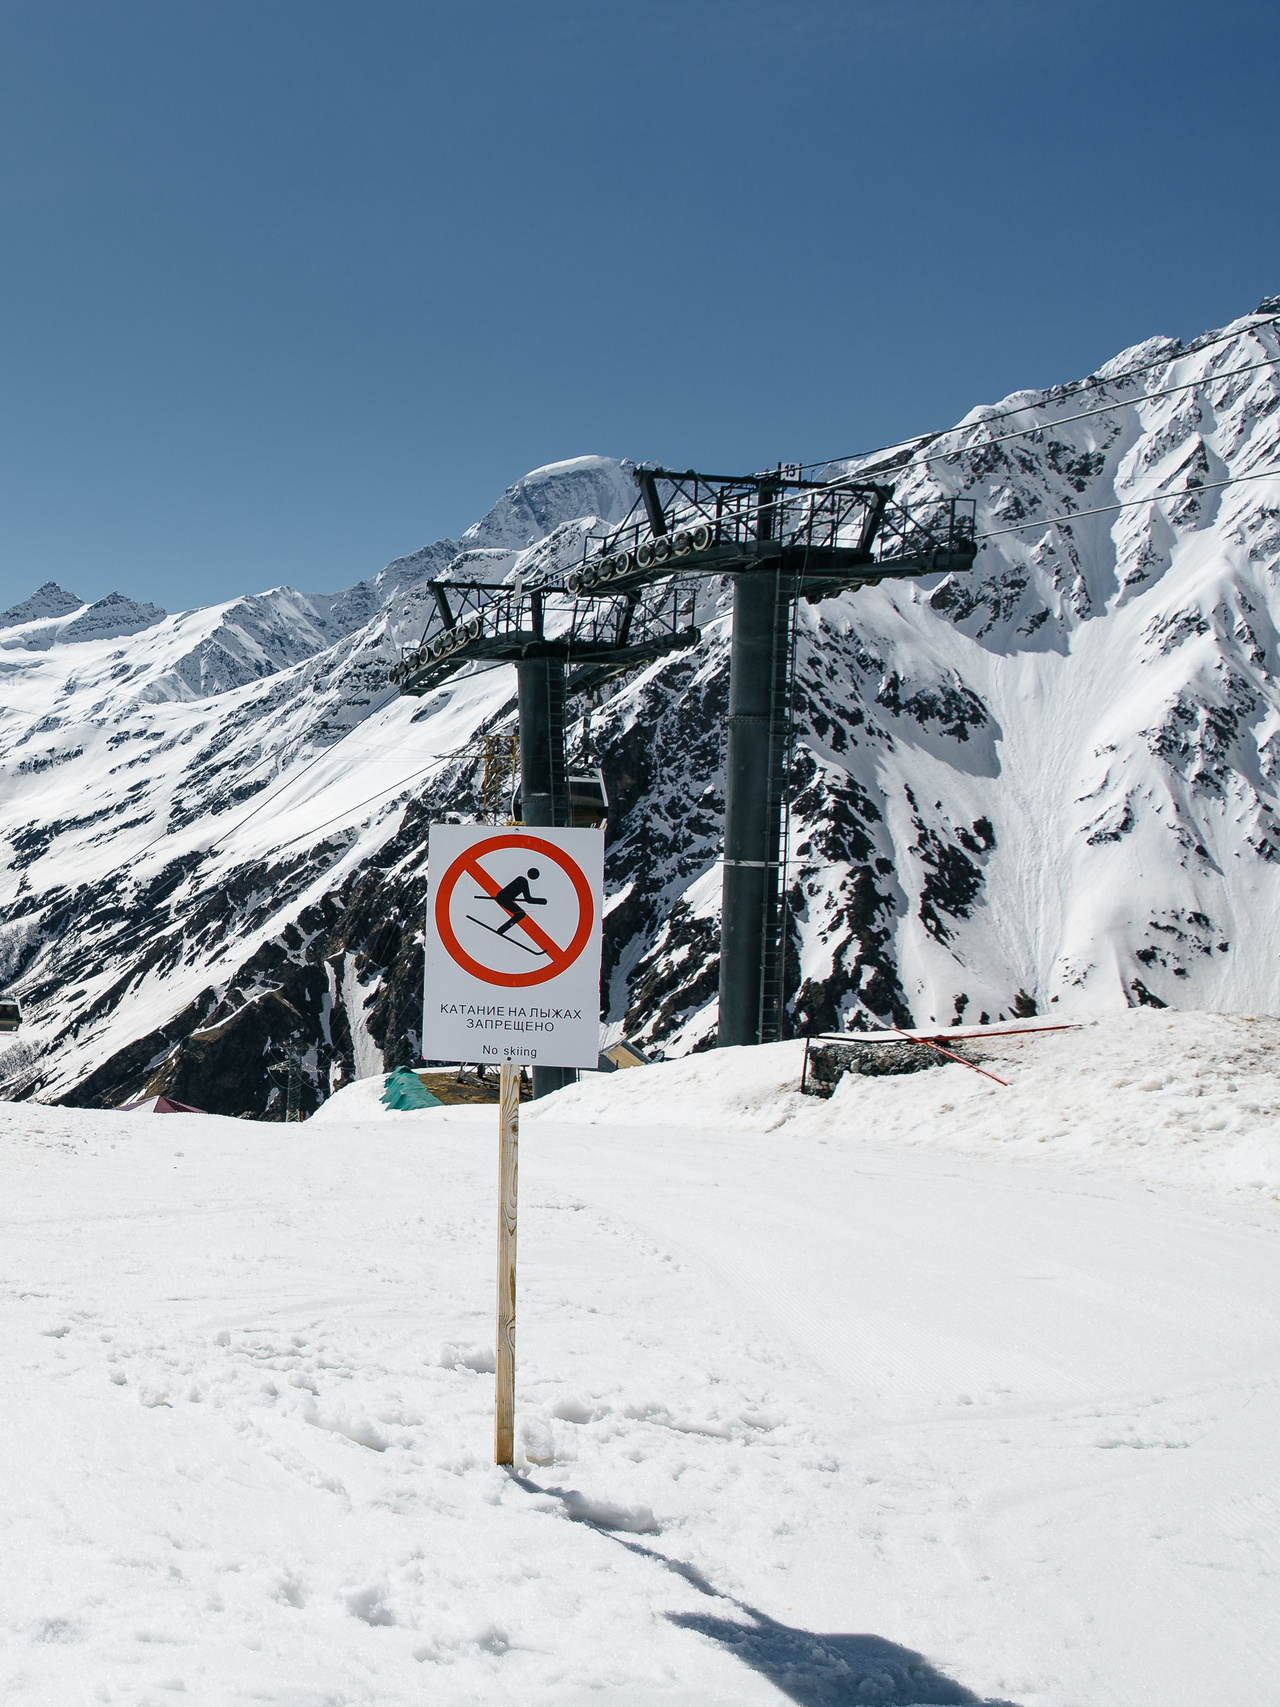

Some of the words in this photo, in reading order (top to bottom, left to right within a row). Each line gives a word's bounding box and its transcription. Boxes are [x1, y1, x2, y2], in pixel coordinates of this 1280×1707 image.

[440, 1003, 505, 1017] КАТАНИЕ
[508, 1007, 527, 1018] НА
[529, 1008, 582, 1020] ЛЫЖАХ
[466, 1018, 554, 1033] ЗАПРЕЩЕНО
[482, 1045, 498, 1055] No
[503, 1046, 537, 1059] skiing
